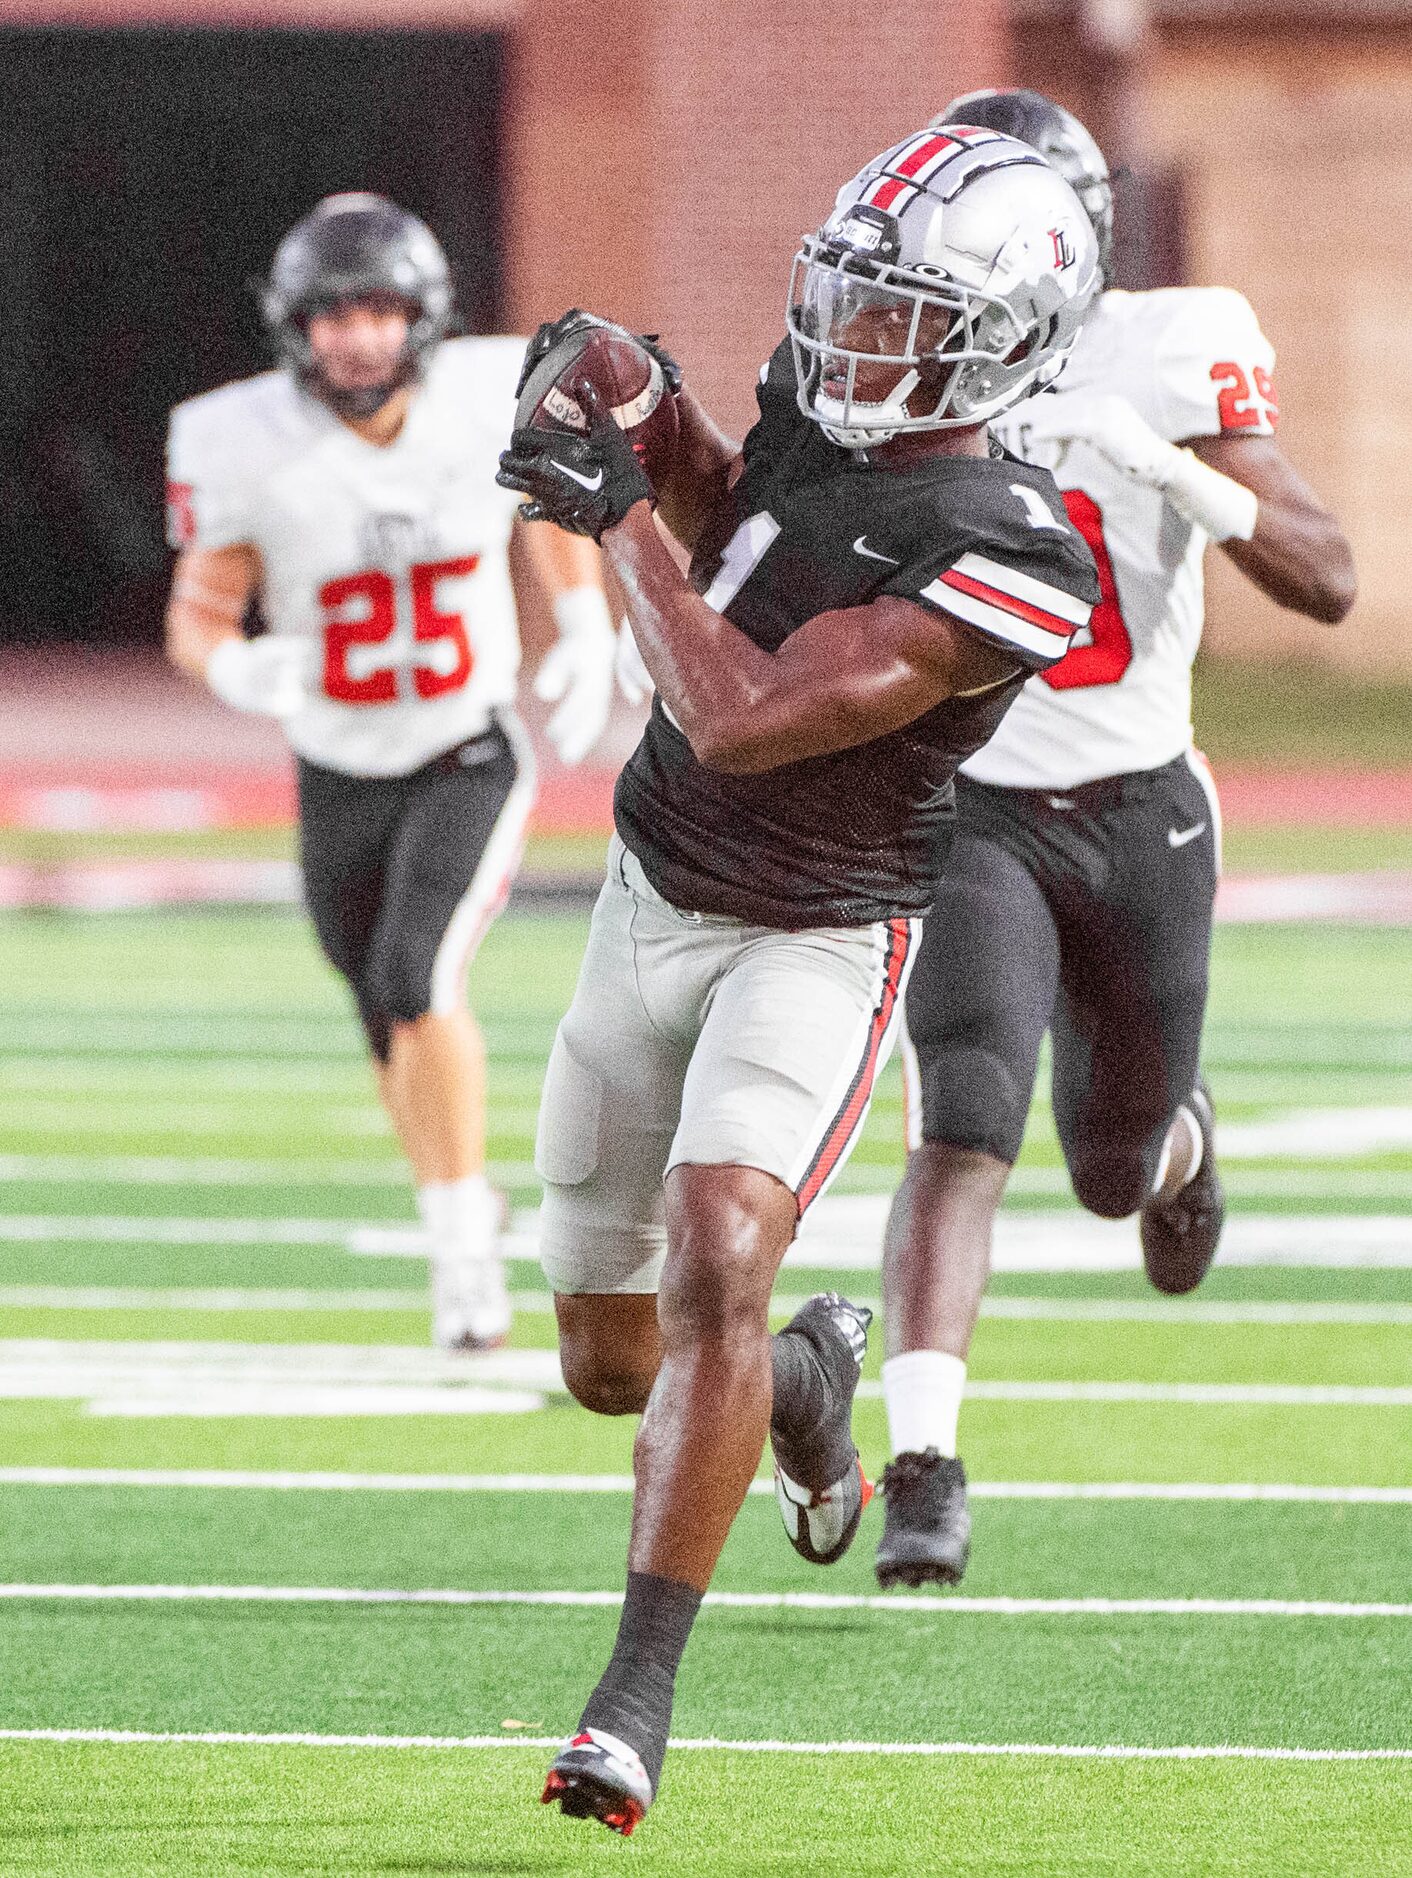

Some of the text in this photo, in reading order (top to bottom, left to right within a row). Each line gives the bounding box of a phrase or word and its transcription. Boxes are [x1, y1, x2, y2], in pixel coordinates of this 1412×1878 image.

[1009, 483, 1071, 535] 1
[702, 510, 782, 614] 1
[318, 553, 480, 707] 25
